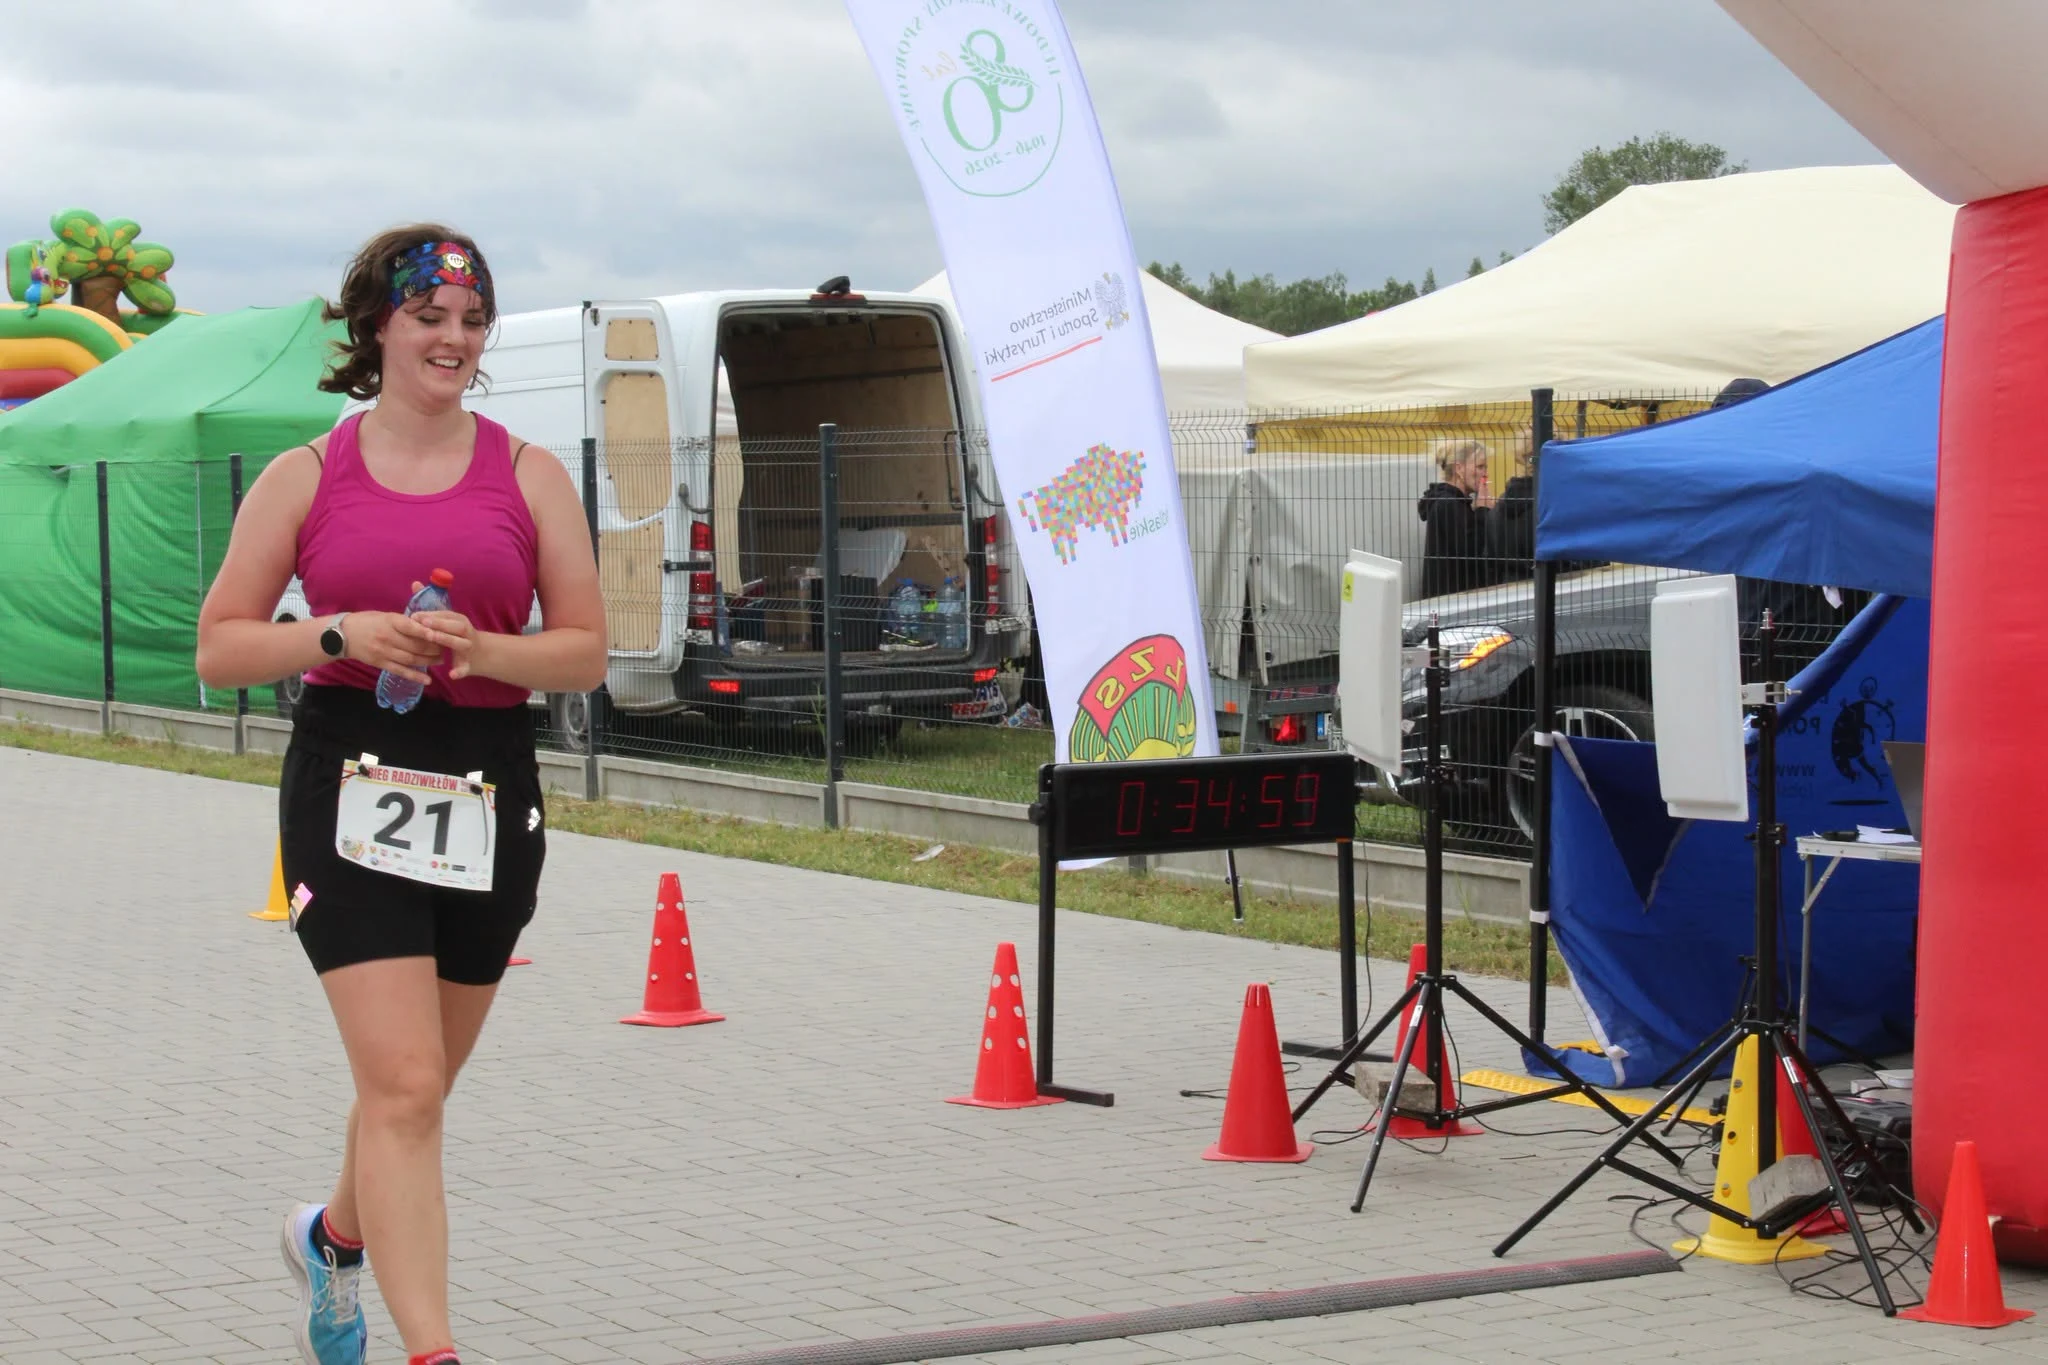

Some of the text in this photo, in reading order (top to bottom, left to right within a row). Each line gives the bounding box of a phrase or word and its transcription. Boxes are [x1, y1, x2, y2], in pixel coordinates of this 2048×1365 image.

[368, 767, 389, 782] BIEG
[392, 770, 458, 791] RADZIWIŁŁÓW
[1117, 773, 1320, 836] 0:34:59
[374, 792, 453, 855] 21
